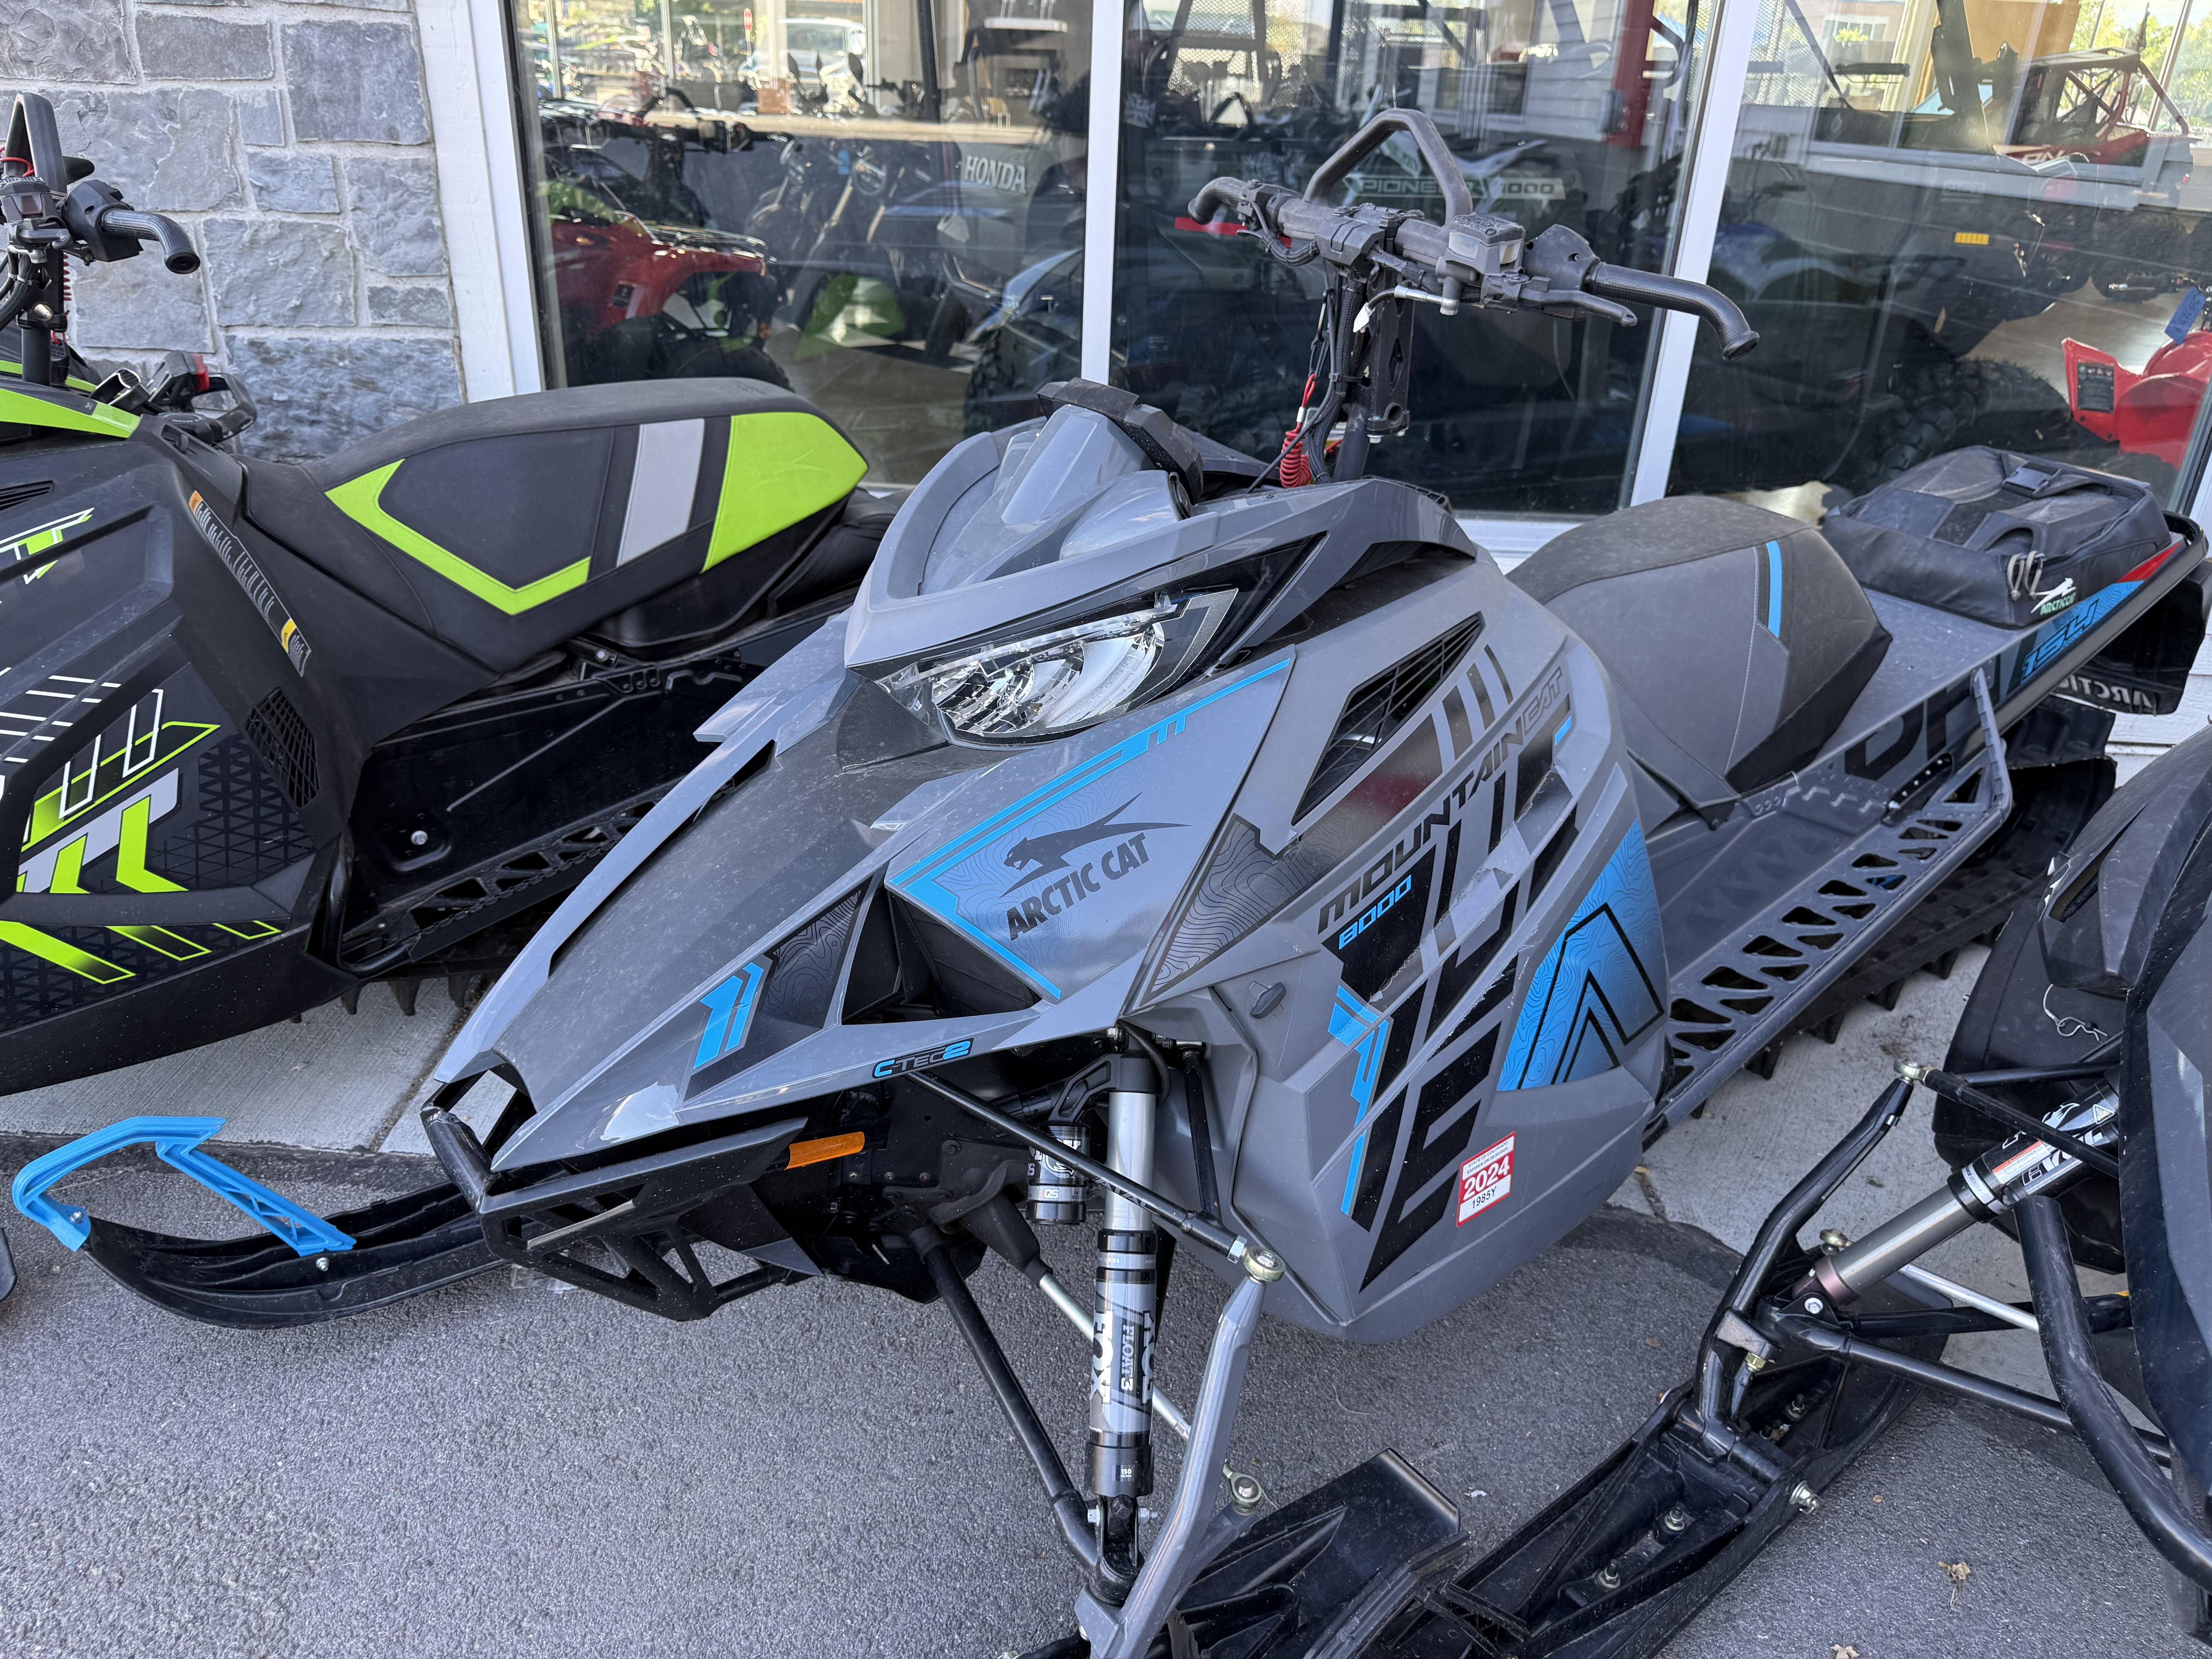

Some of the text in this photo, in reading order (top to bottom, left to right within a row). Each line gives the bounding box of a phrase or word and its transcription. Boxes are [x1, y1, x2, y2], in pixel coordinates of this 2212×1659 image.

[964, 155, 1026, 194] HONDA
[1361, 179, 1474, 194] PIONE
[2021, 599, 2099, 680] 154
[1006, 832, 1149, 941] ARCTIC CAT
[1339, 874, 1412, 950] 8000
[1467, 1162, 1483, 1174] EXPIRES
[1468, 1157, 1480, 1167] STATE
[1487, 1141, 1508, 1156] COLORADO
[1463, 1155, 1510, 1201] 2024
[1472, 1185, 1497, 1209] 1985Y
[1090, 1310, 1113, 1405] FOX
[1121, 1324, 1134, 1391] FLOAT 3
